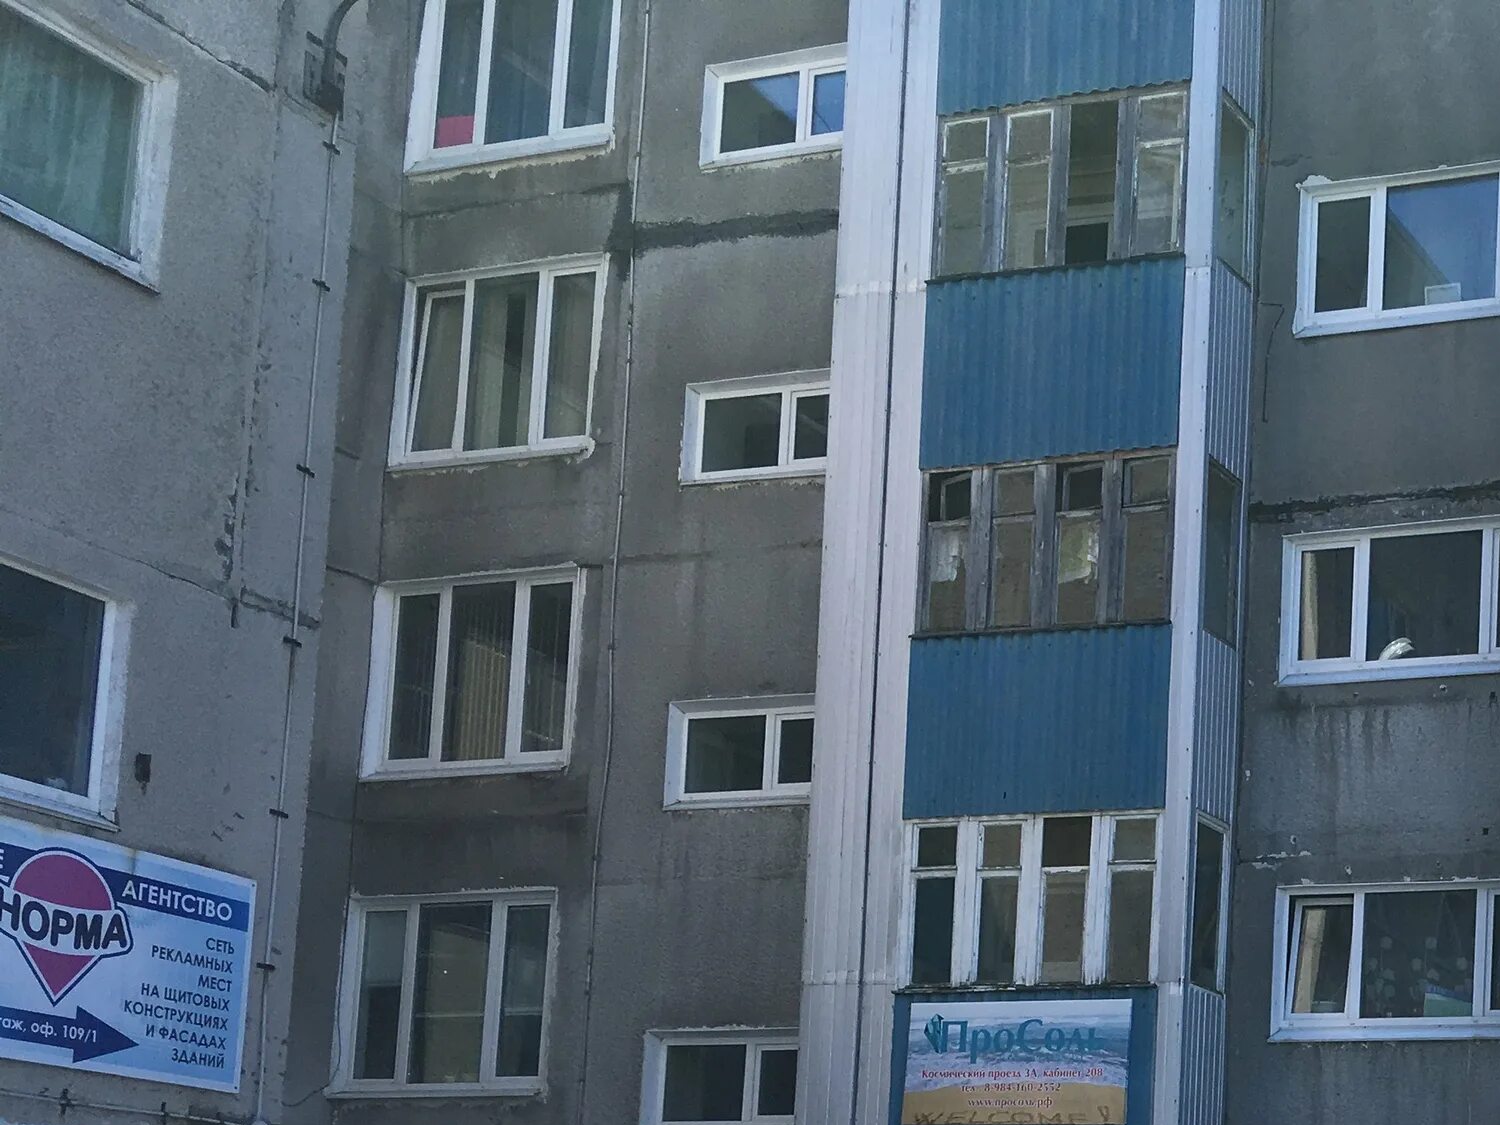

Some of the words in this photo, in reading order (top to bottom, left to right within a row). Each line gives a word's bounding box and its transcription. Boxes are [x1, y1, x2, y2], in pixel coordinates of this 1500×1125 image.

[121, 879, 233, 922] АГЕНТСТВО
[0, 885, 127, 950] НОРМА
[205, 937, 235, 954] СЕТЬ
[151, 946, 233, 973] РЕКЛАМНЫХ
[198, 974, 232, 992] МЕСТ
[141, 983, 160, 997] НА
[164, 987, 229, 1011] ЩИТОВЫХ
[124, 1000, 228, 1030] КОНСТРУКЦИЯХ
[31, 1021, 57, 1038] оф.
[62, 1024, 97, 1044] 109/1
[146, 1024, 154, 1037] И
[159, 1028, 226, 1050] ФАСАДАХ
[171, 1046, 225, 1069] ЗДАНИЙ
[1085, 1067, 1103, 1077] 208
